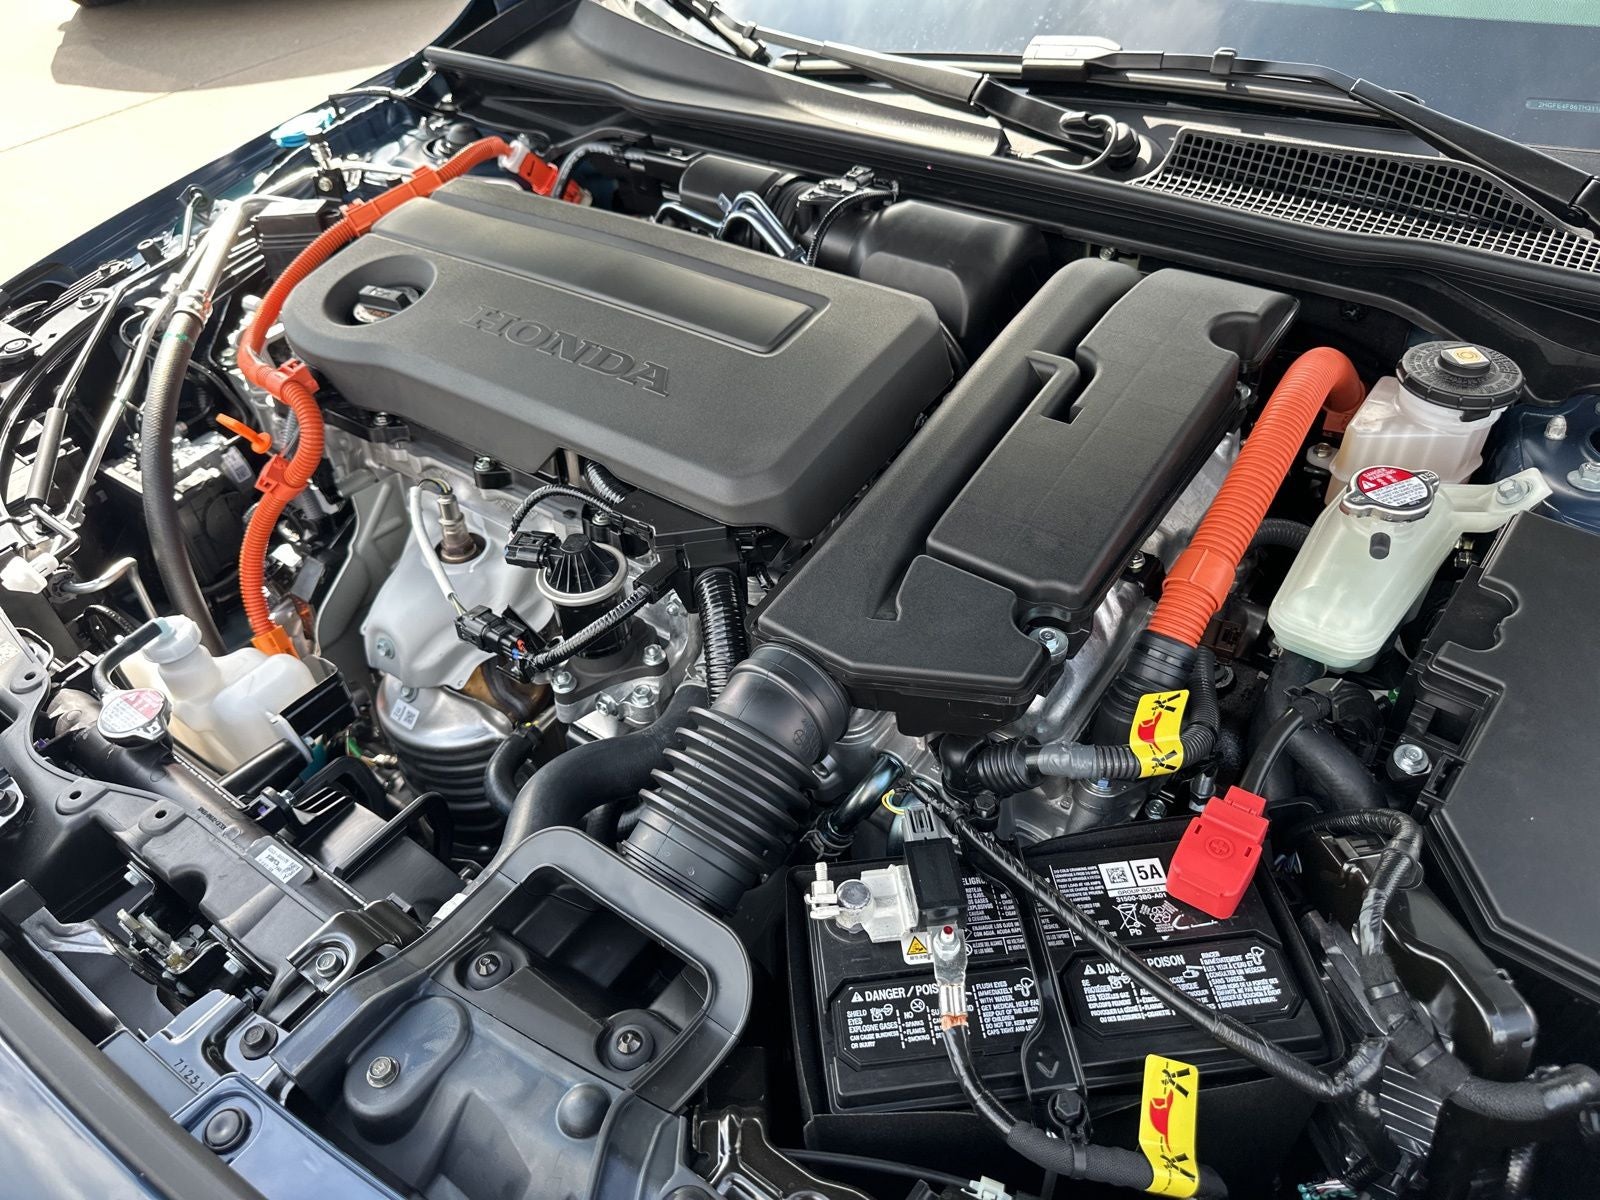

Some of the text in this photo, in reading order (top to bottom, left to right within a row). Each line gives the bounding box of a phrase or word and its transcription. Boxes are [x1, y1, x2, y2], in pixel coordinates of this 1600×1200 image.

[459, 304, 669, 398] HONDA
[1136, 864, 1162, 880] 5A
[1129, 928, 1142, 936] Pb
[1146, 954, 1186, 968] POISON
[976, 980, 1008, 990] FLUSH EYES
[993, 1002, 1015, 1010] MEDICAL
[846, 1010, 867, 1018] SHIELD
[849, 1021, 899, 1033] EXPLOSIVE GASES
[174, 1058, 205, 1090] 71251
